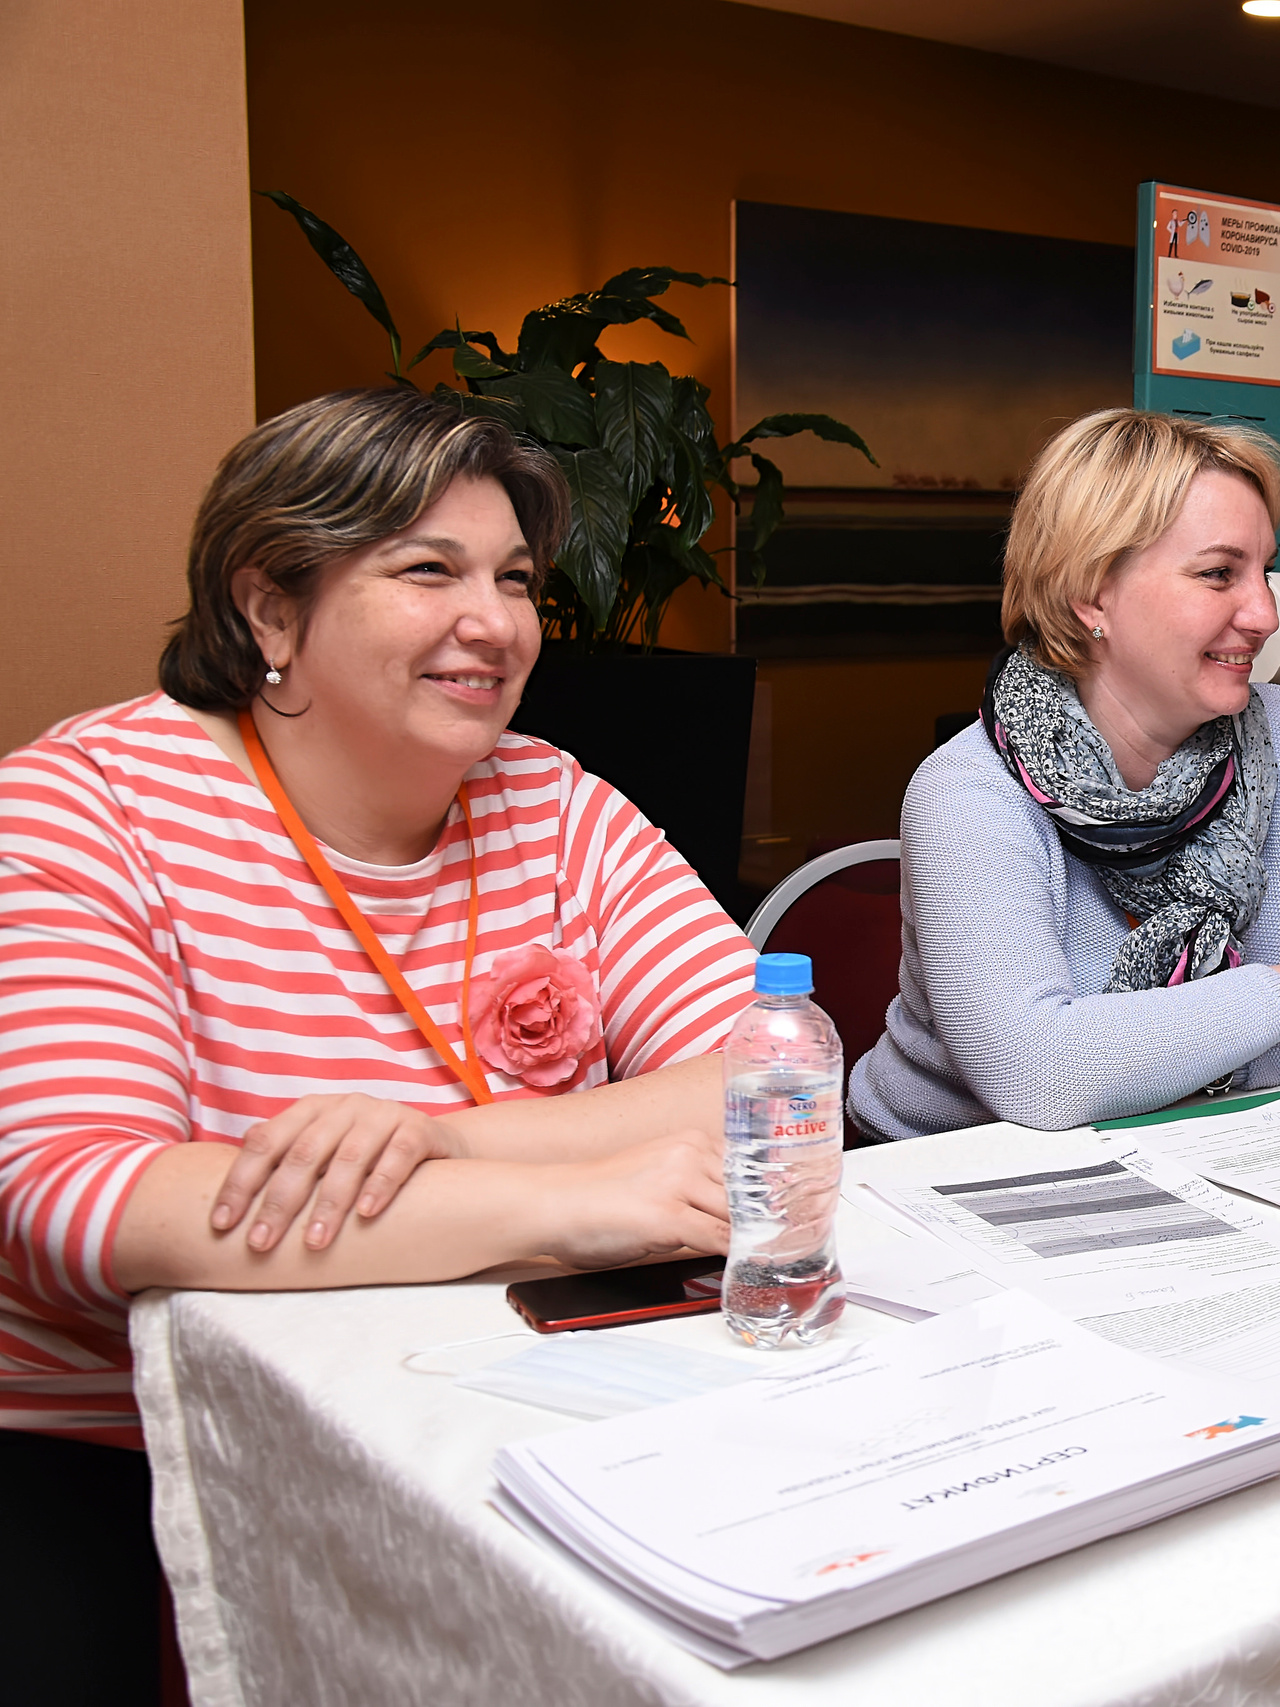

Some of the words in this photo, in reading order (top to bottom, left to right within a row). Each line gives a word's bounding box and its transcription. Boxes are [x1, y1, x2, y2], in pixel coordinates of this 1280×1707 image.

[1221, 217, 1243, 229] МЕРЫ
[1221, 230, 1278, 246] КОРОНАВИРУСА
[1221, 242, 1260, 256] COVID-2019
[1163, 300, 1189, 310] Избегайте
[774, 1119, 827, 1137] active
[900, 1445, 1089, 1512] СЕРТИФИКАТ
